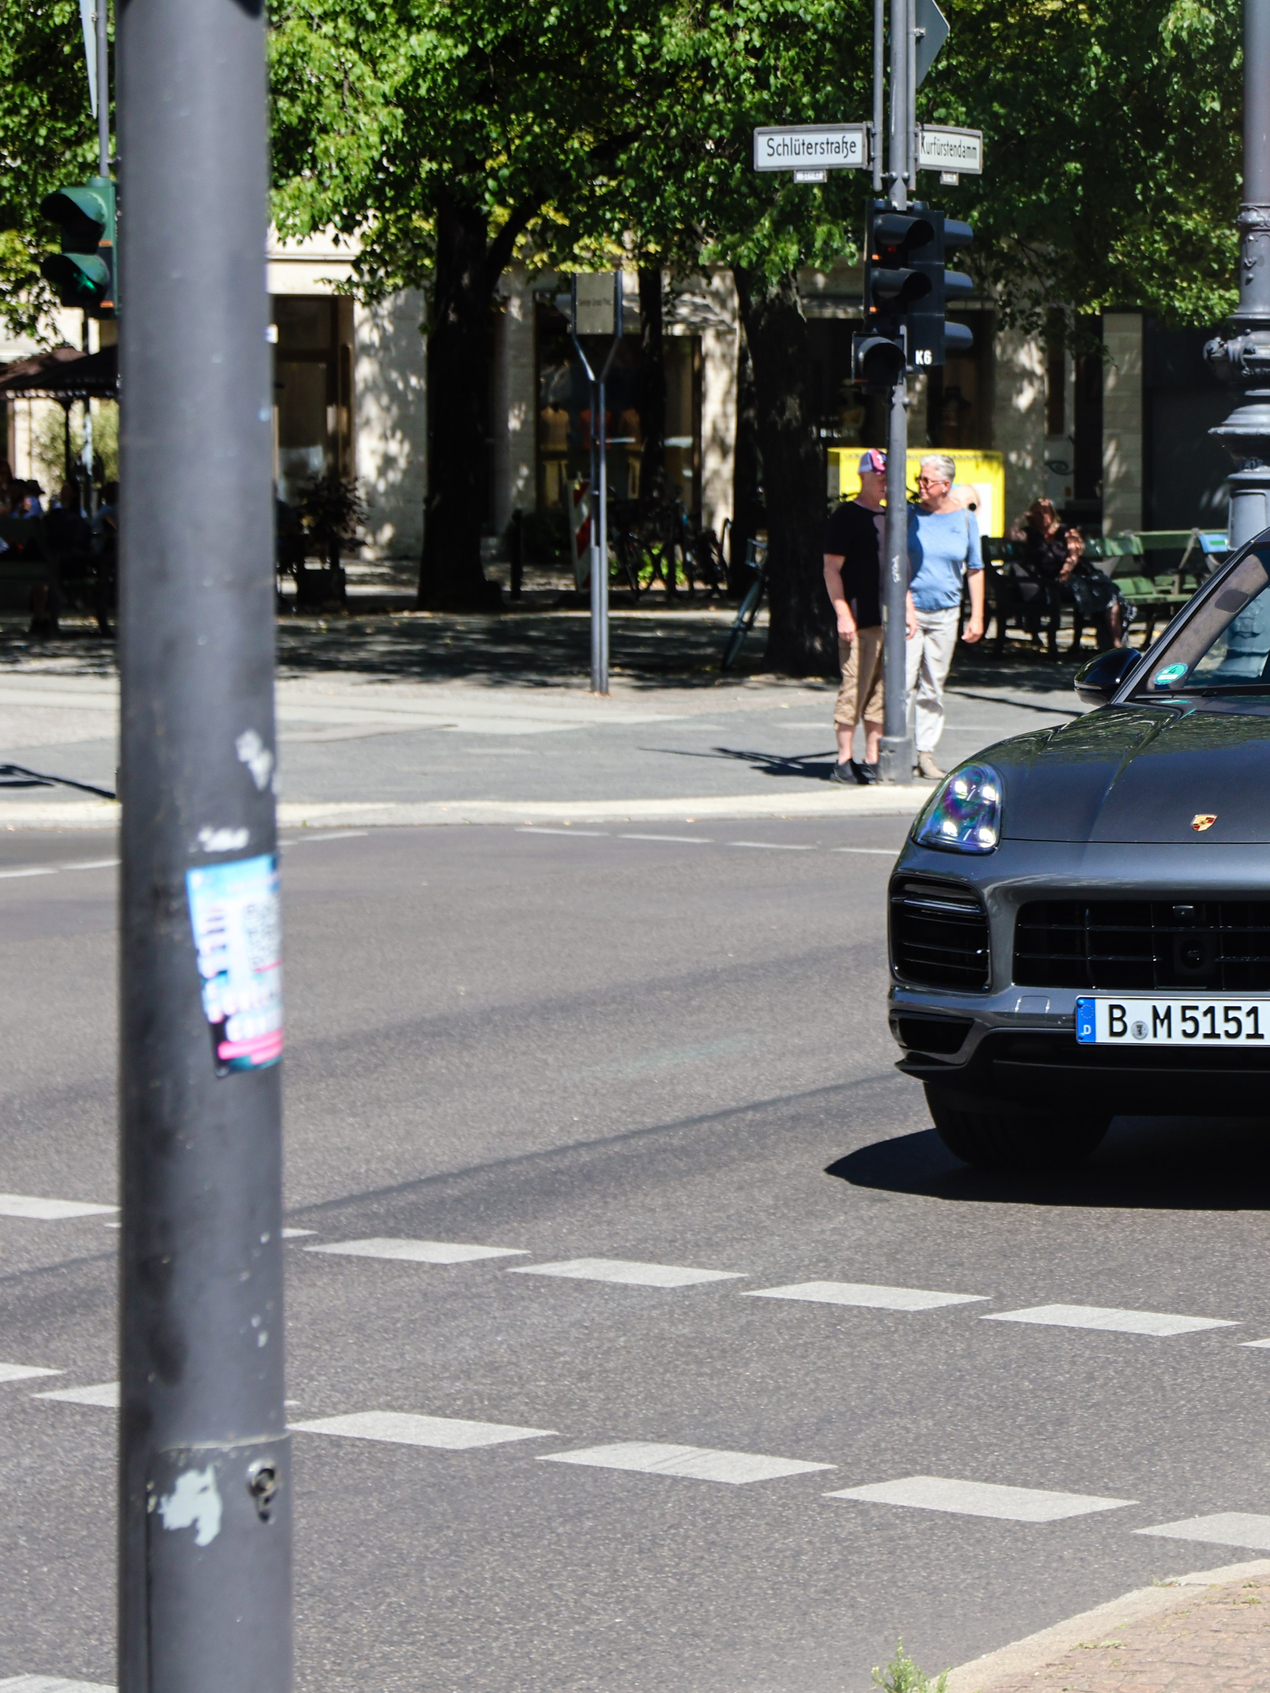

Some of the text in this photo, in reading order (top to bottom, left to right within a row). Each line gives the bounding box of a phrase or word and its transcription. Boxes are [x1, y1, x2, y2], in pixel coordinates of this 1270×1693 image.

[766, 135, 857, 159] Schlüterstraße
[920, 133, 977, 159] Kurfürstendamm
[915, 350, 932, 365] K6
[1083, 1024, 1092, 1035] D
[1108, 1004, 1265, 1039] B M 5151
